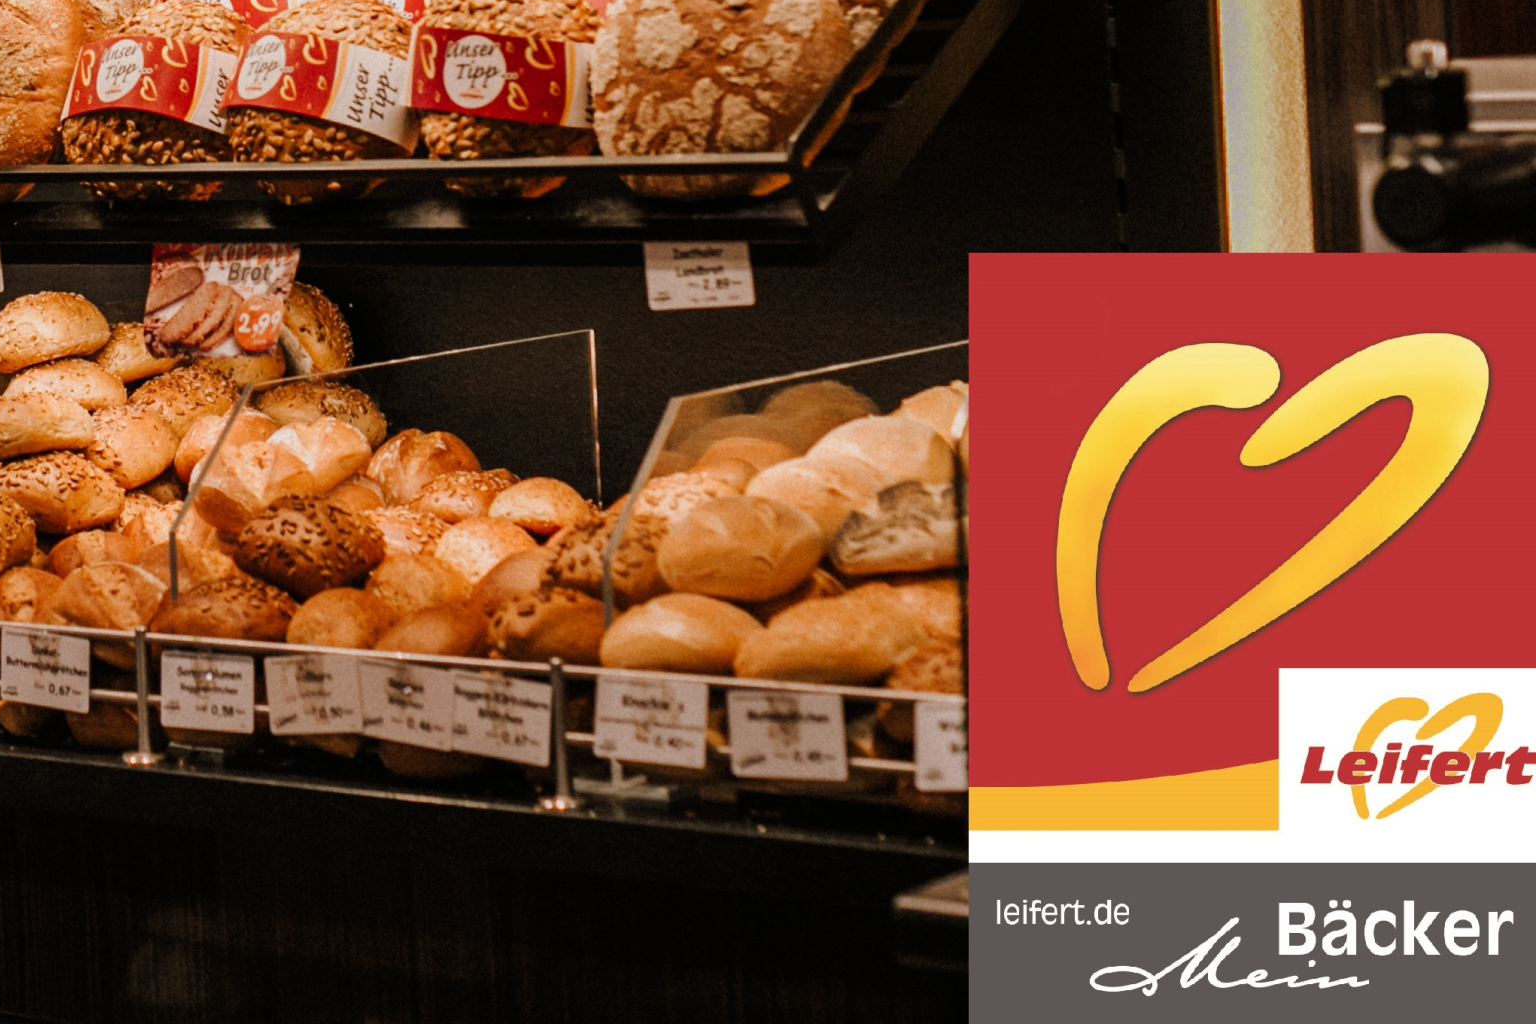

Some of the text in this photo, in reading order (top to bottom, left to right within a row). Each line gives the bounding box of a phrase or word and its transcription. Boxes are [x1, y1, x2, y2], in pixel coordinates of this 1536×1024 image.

[101, 42, 143, 65] Unser
[346, 63, 370, 124] Unser
[227, 262, 270, 284] Brot
[238, 311, 282, 338] 2,99
[49, 683, 71, 697] 0,67
